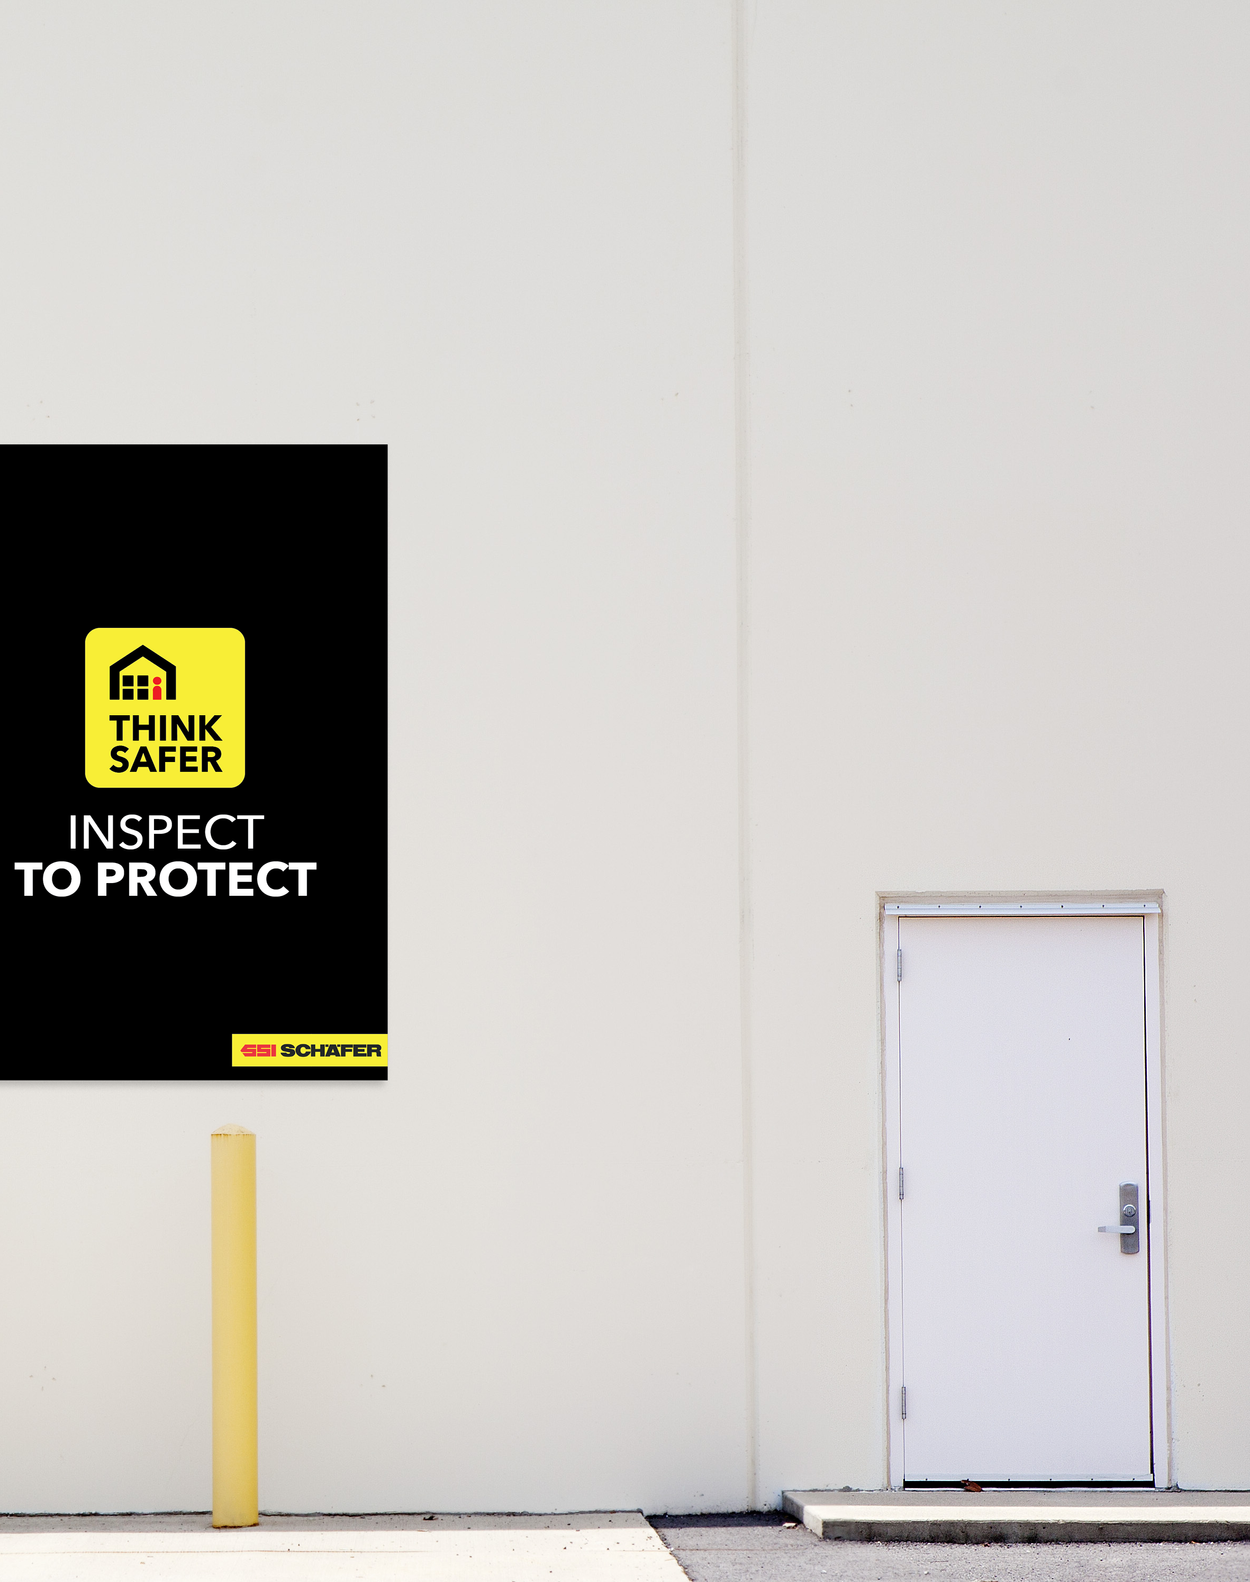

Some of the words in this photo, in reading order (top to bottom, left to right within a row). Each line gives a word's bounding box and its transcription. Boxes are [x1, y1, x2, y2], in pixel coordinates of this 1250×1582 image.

[109, 715, 222, 741] THINK
[110, 745, 222, 773] SAFER
[71, 814, 264, 850] INSPECT
[14, 861, 81, 897] TO
[98, 861, 317, 897] PROTECT
[281, 1044, 381, 1057] SCHÄFER
